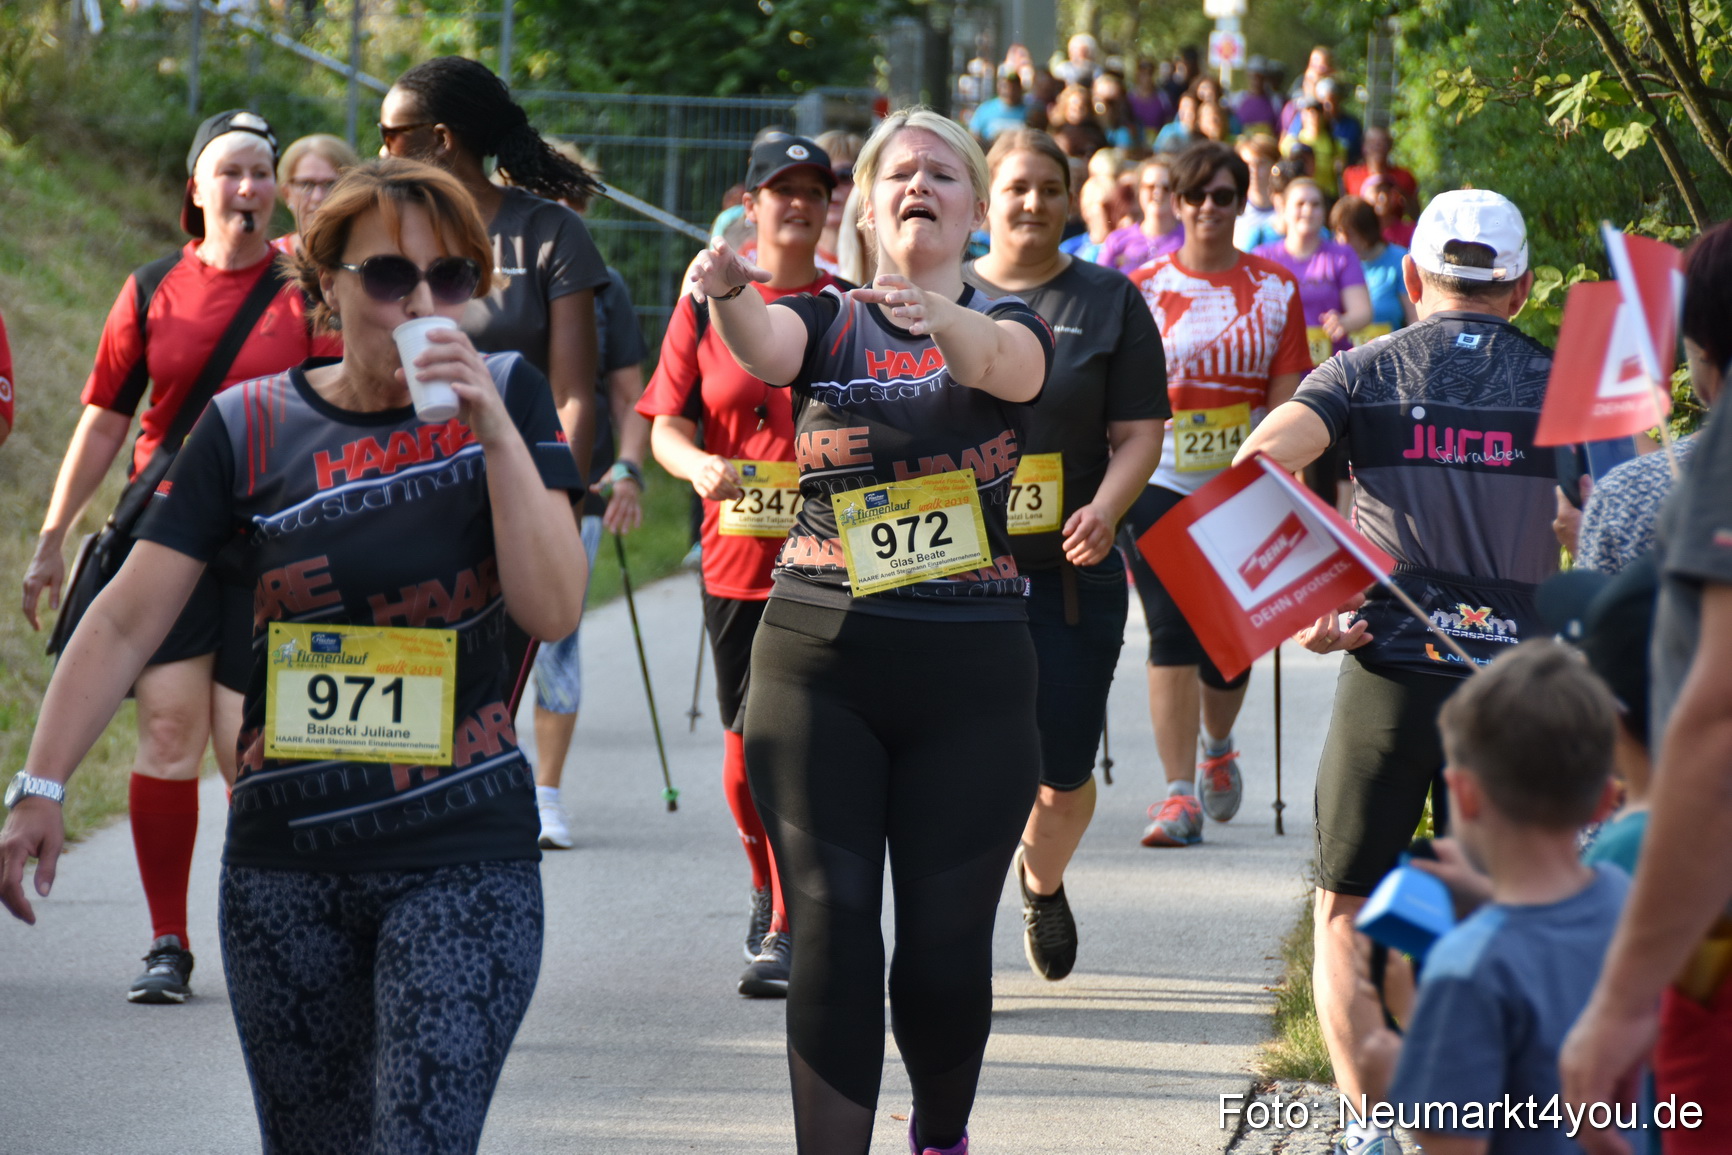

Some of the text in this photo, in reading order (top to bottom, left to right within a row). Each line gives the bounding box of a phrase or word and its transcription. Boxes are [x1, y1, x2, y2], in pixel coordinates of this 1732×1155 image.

[795, 426, 873, 472] ARE
[1185, 426, 1241, 454] 2214
[1434, 443, 1525, 465] Schrauben
[732, 487, 801, 515] 2347
[857, 499, 911, 520] firmenlauf
[871, 510, 953, 560] 972
[890, 550, 946, 569] Glas Beate
[1258, 533, 1290, 570] DEHN
[1250, 559, 1352, 629] DEHN protects.
[297, 649, 443, 677] firmenlauf walk 2019
[307, 674, 403, 724] 971
[276, 735, 440, 750] HAARE Anett Steinmann Einzelunternehmen
[307, 723, 411, 739] Balacki Juliane
